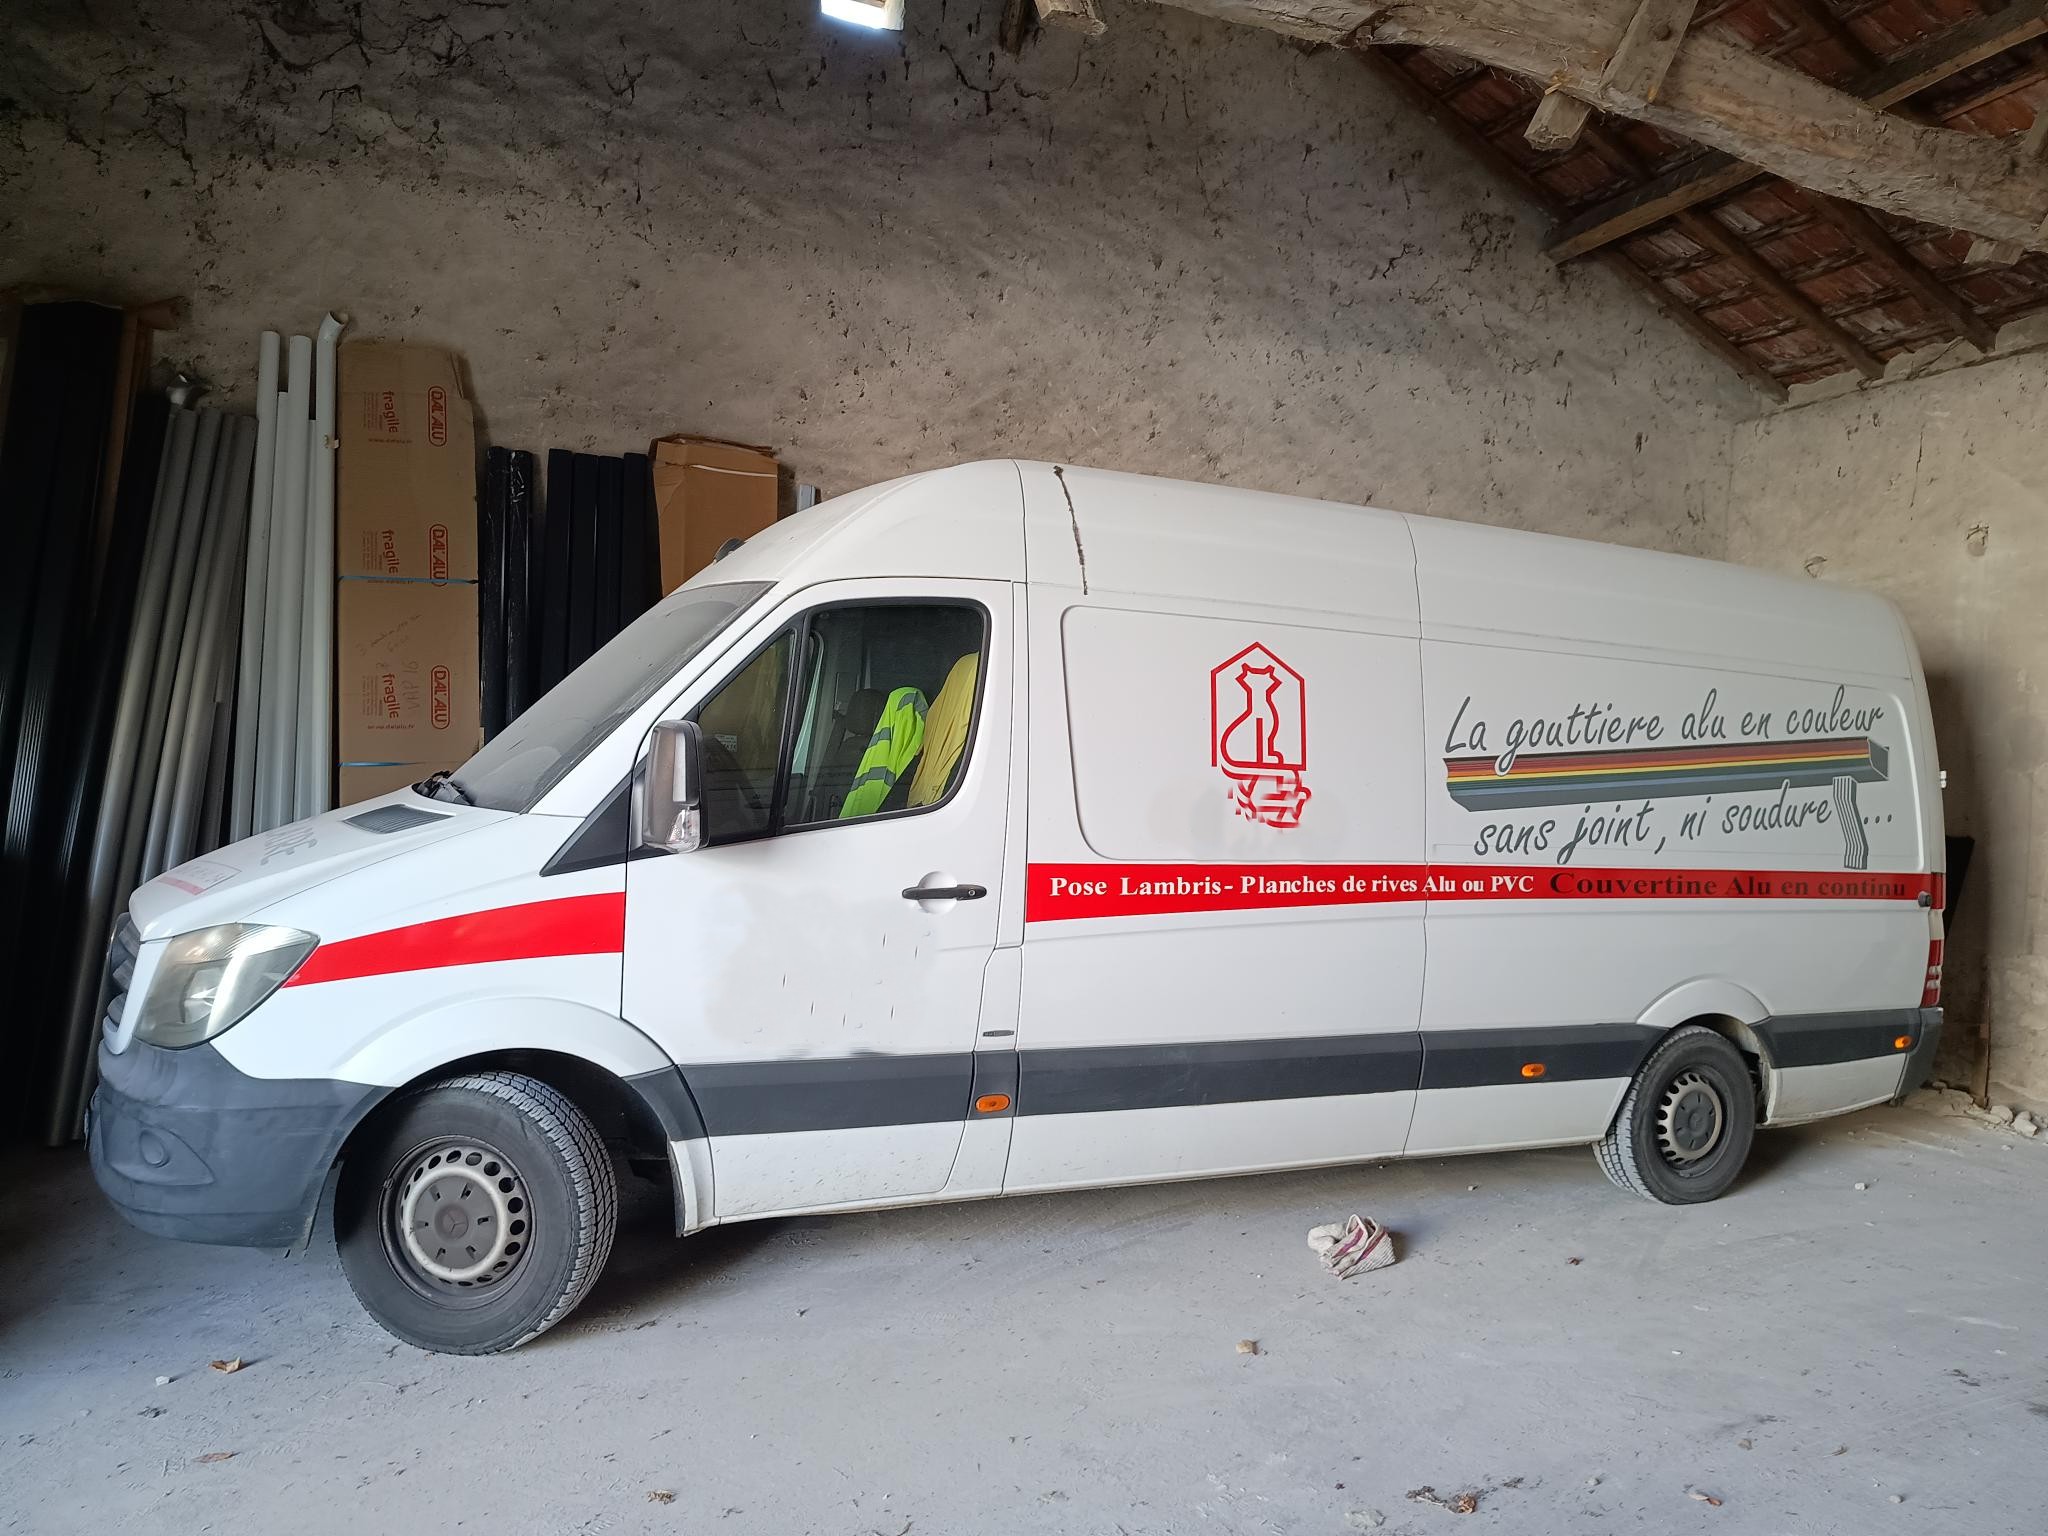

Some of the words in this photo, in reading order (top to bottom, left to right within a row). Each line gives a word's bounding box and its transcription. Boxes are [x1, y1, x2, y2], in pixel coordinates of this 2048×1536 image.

[382, 391, 400, 433] fragile
[382, 529, 400, 574] fragile
[382, 673, 400, 718] fragile
[1445, 696, 1486, 753] La
[1498, 703, 1664, 773] gouttiere
[1681, 688, 1726, 740] alu
[1741, 712, 1771, 739] en
[1786, 684, 1884, 734] couleur
[1474, 819, 1555, 856] sans
[1680, 796, 1711, 840] ni
[1049, 877, 1107, 897] Pose
[1240, 875, 1336, 894] Planches
[1342, 875, 1366, 893] de
[1371, 876, 1418, 893] rives
[1422, 875, 1456, 893] Alu
[1462, 879, 1484, 893] ou
[1491, 875, 1534, 893] PVC
[1550, 872, 1717, 896] Couvertine
[1724, 876, 1771, 896] Alu
[1781, 879, 1809, 896] en
[1818, 878, 1906, 897] continu
